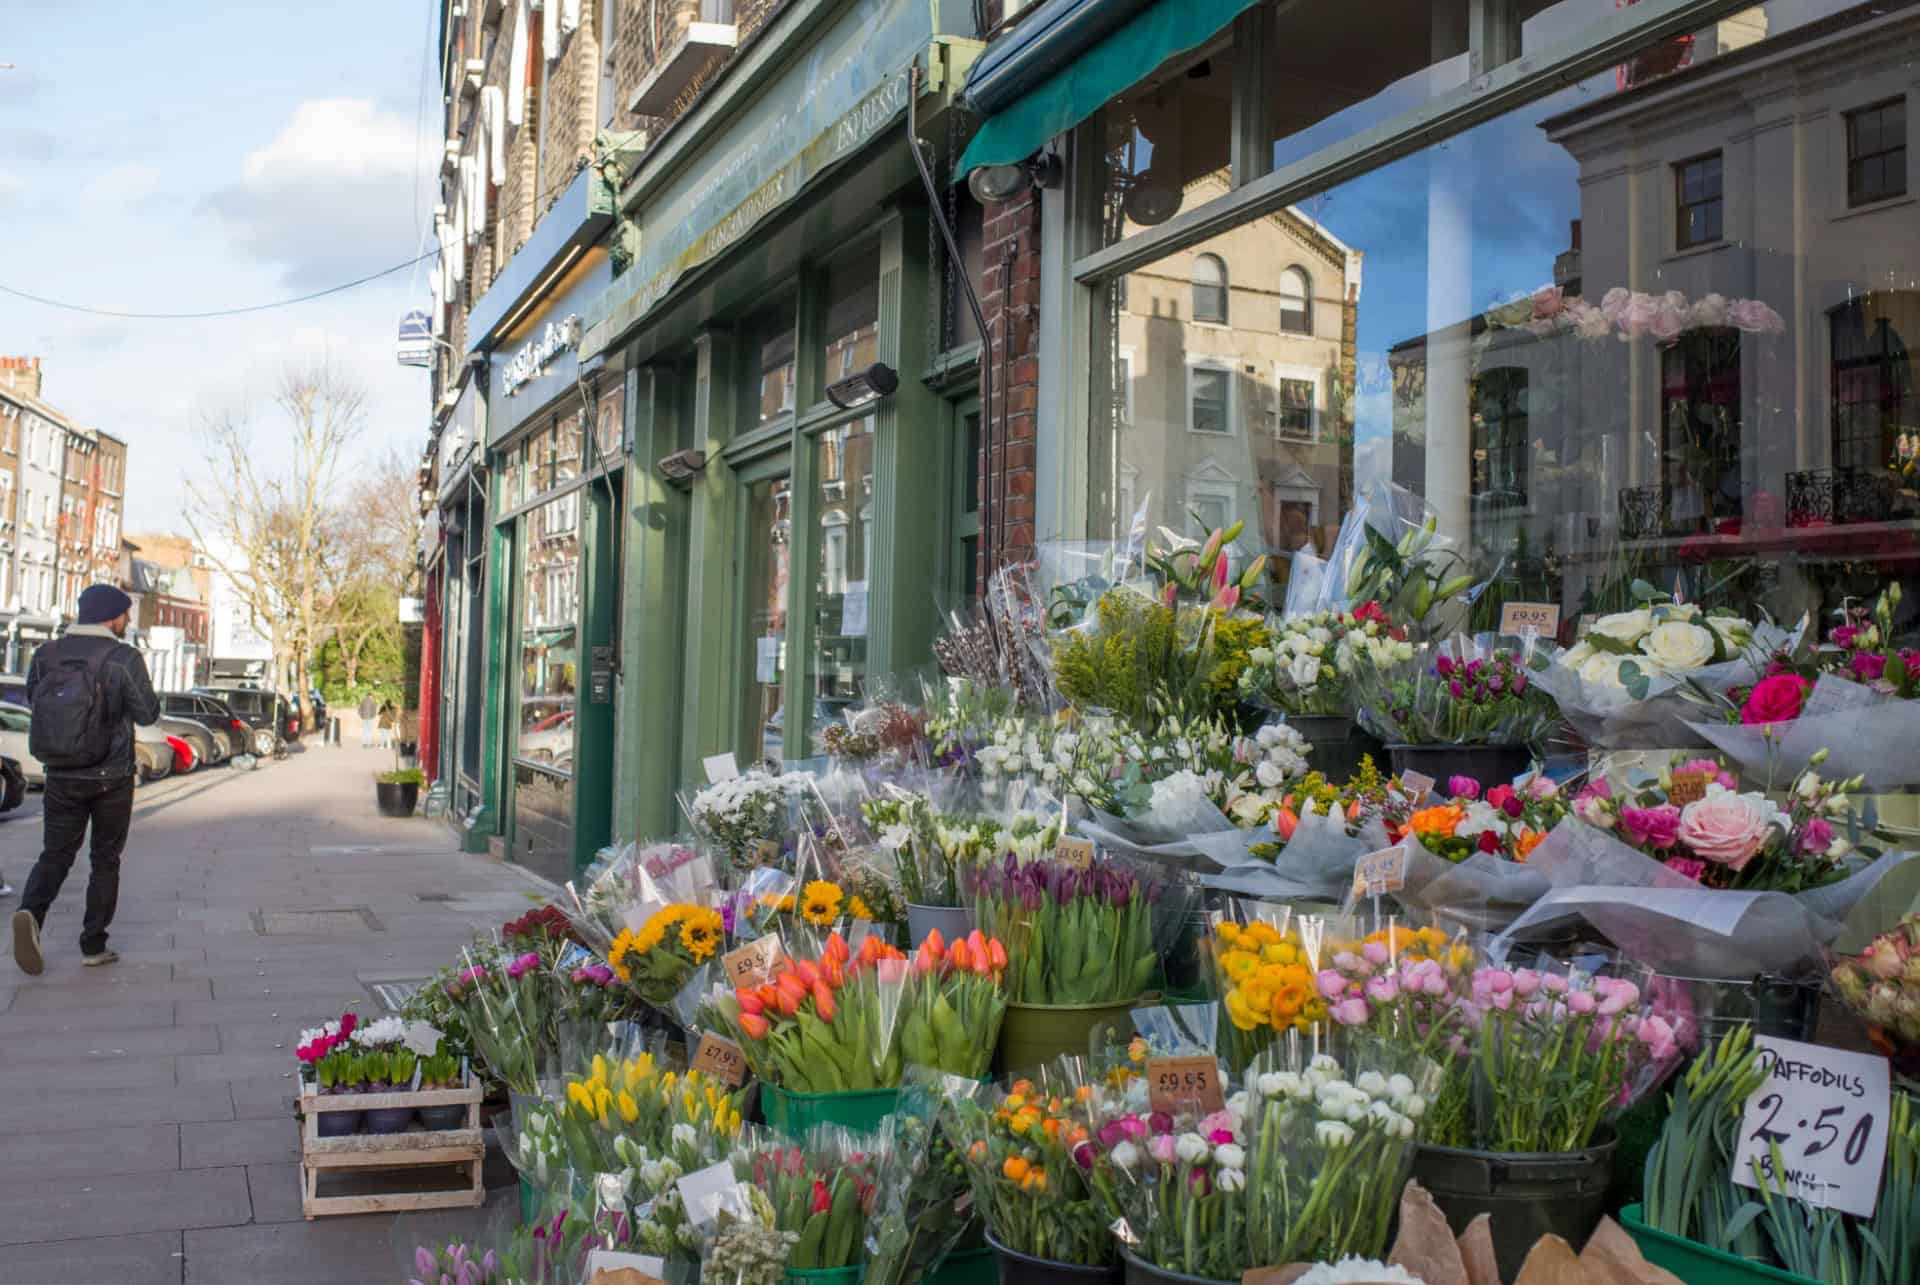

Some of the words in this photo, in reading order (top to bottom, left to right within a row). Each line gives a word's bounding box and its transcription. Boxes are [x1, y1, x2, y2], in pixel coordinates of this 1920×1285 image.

[704, 1045, 739, 1067] £7.95
[1760, 1048, 1865, 1097] DAFFODILS
[1159, 1072, 1207, 1092] £9.95
[1750, 1093, 1874, 1165] 2.50
